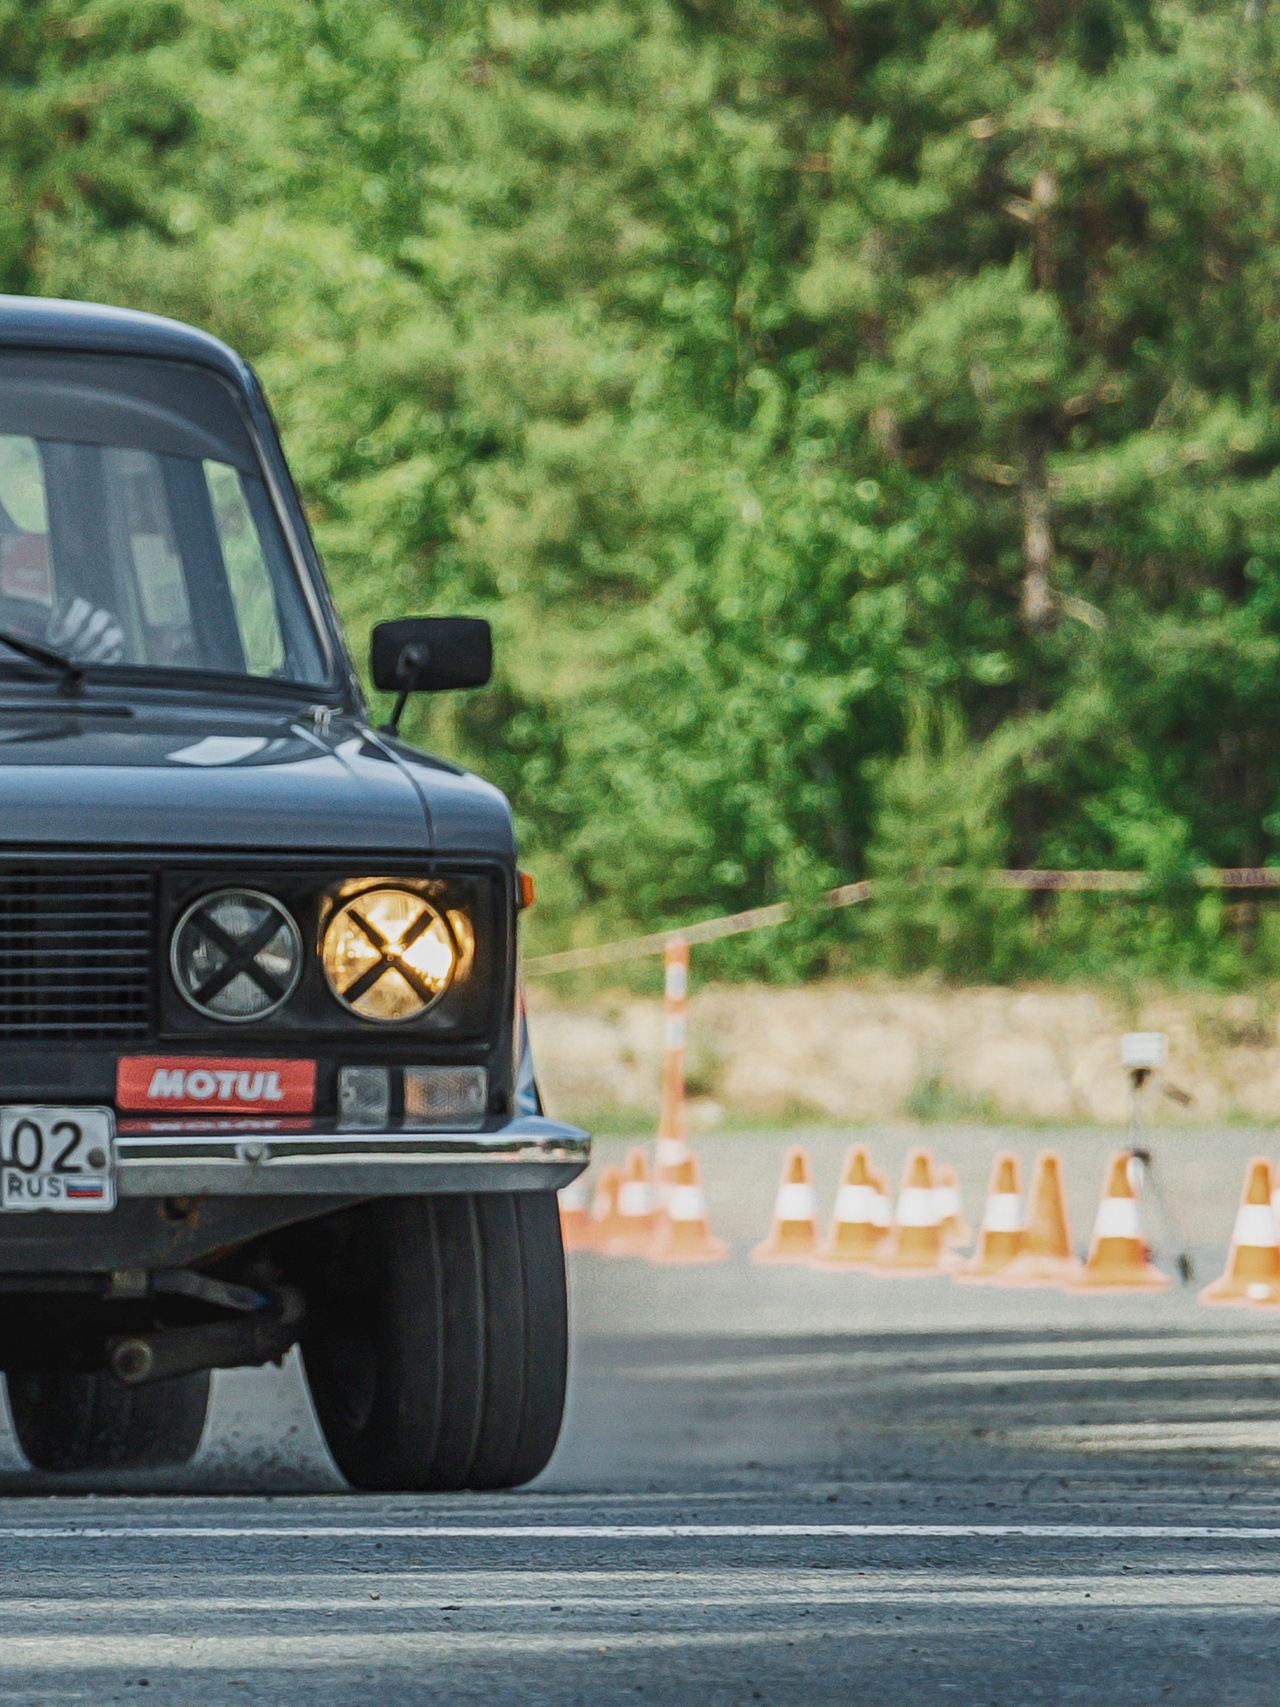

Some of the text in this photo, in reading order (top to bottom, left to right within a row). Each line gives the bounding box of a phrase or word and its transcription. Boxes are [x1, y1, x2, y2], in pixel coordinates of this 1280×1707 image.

[147, 1069, 284, 1101] MOTUL
[11, 1118, 83, 1174] 02
[7, 1172, 62, 1198] RUS
